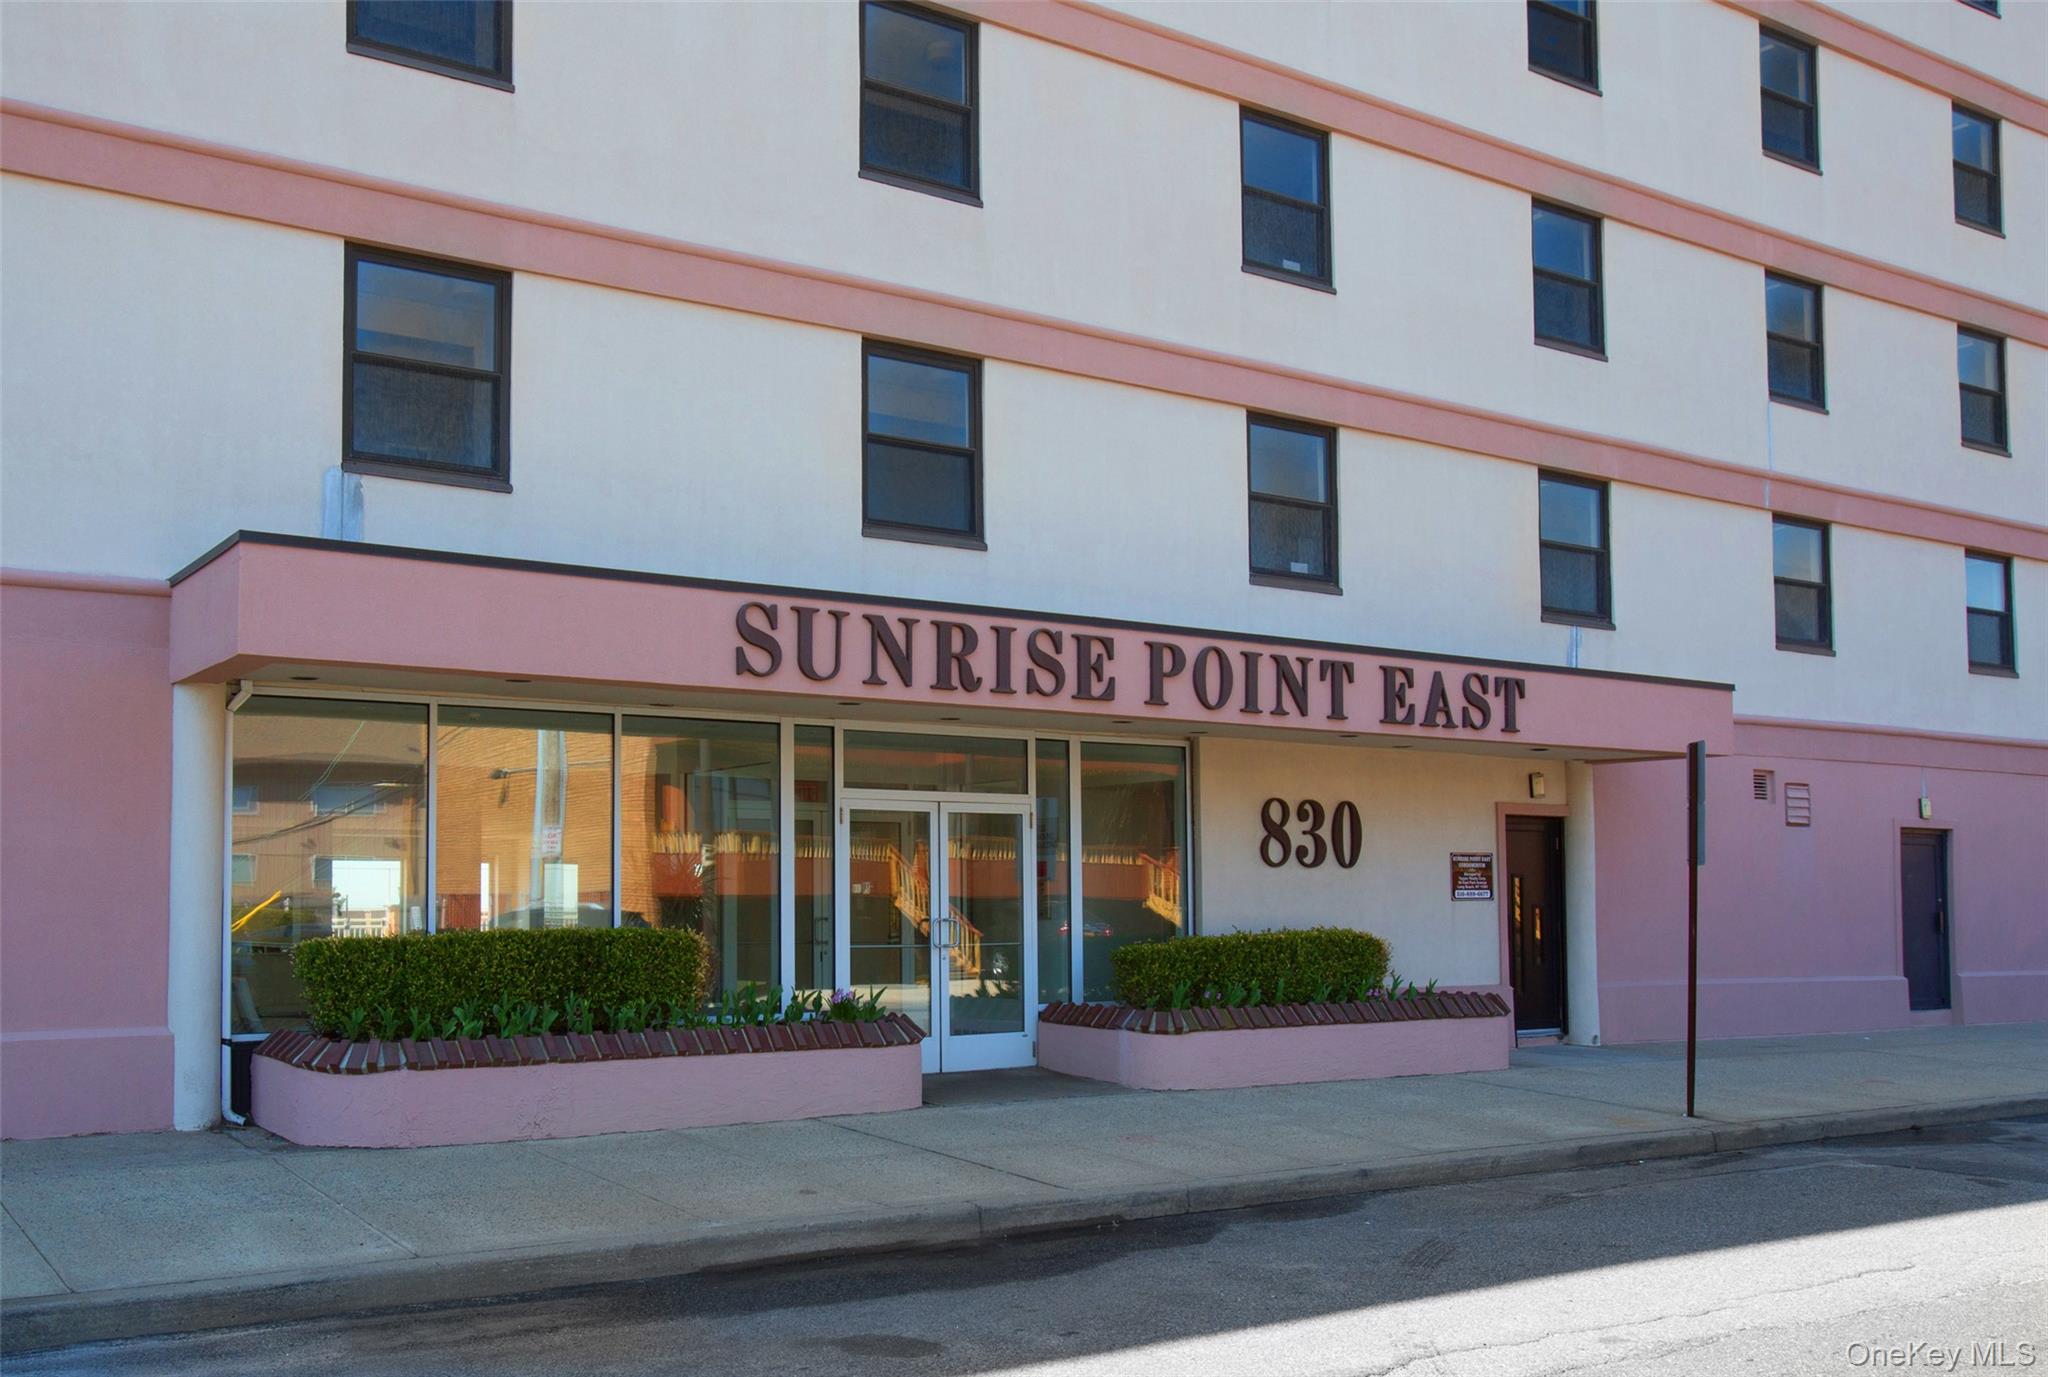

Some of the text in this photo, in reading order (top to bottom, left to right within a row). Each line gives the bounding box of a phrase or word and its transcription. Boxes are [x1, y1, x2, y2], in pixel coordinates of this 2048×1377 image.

[735, 601, 1527, 733] SUNRISE POINT EAST
[1260, 797, 1363, 869] 830
